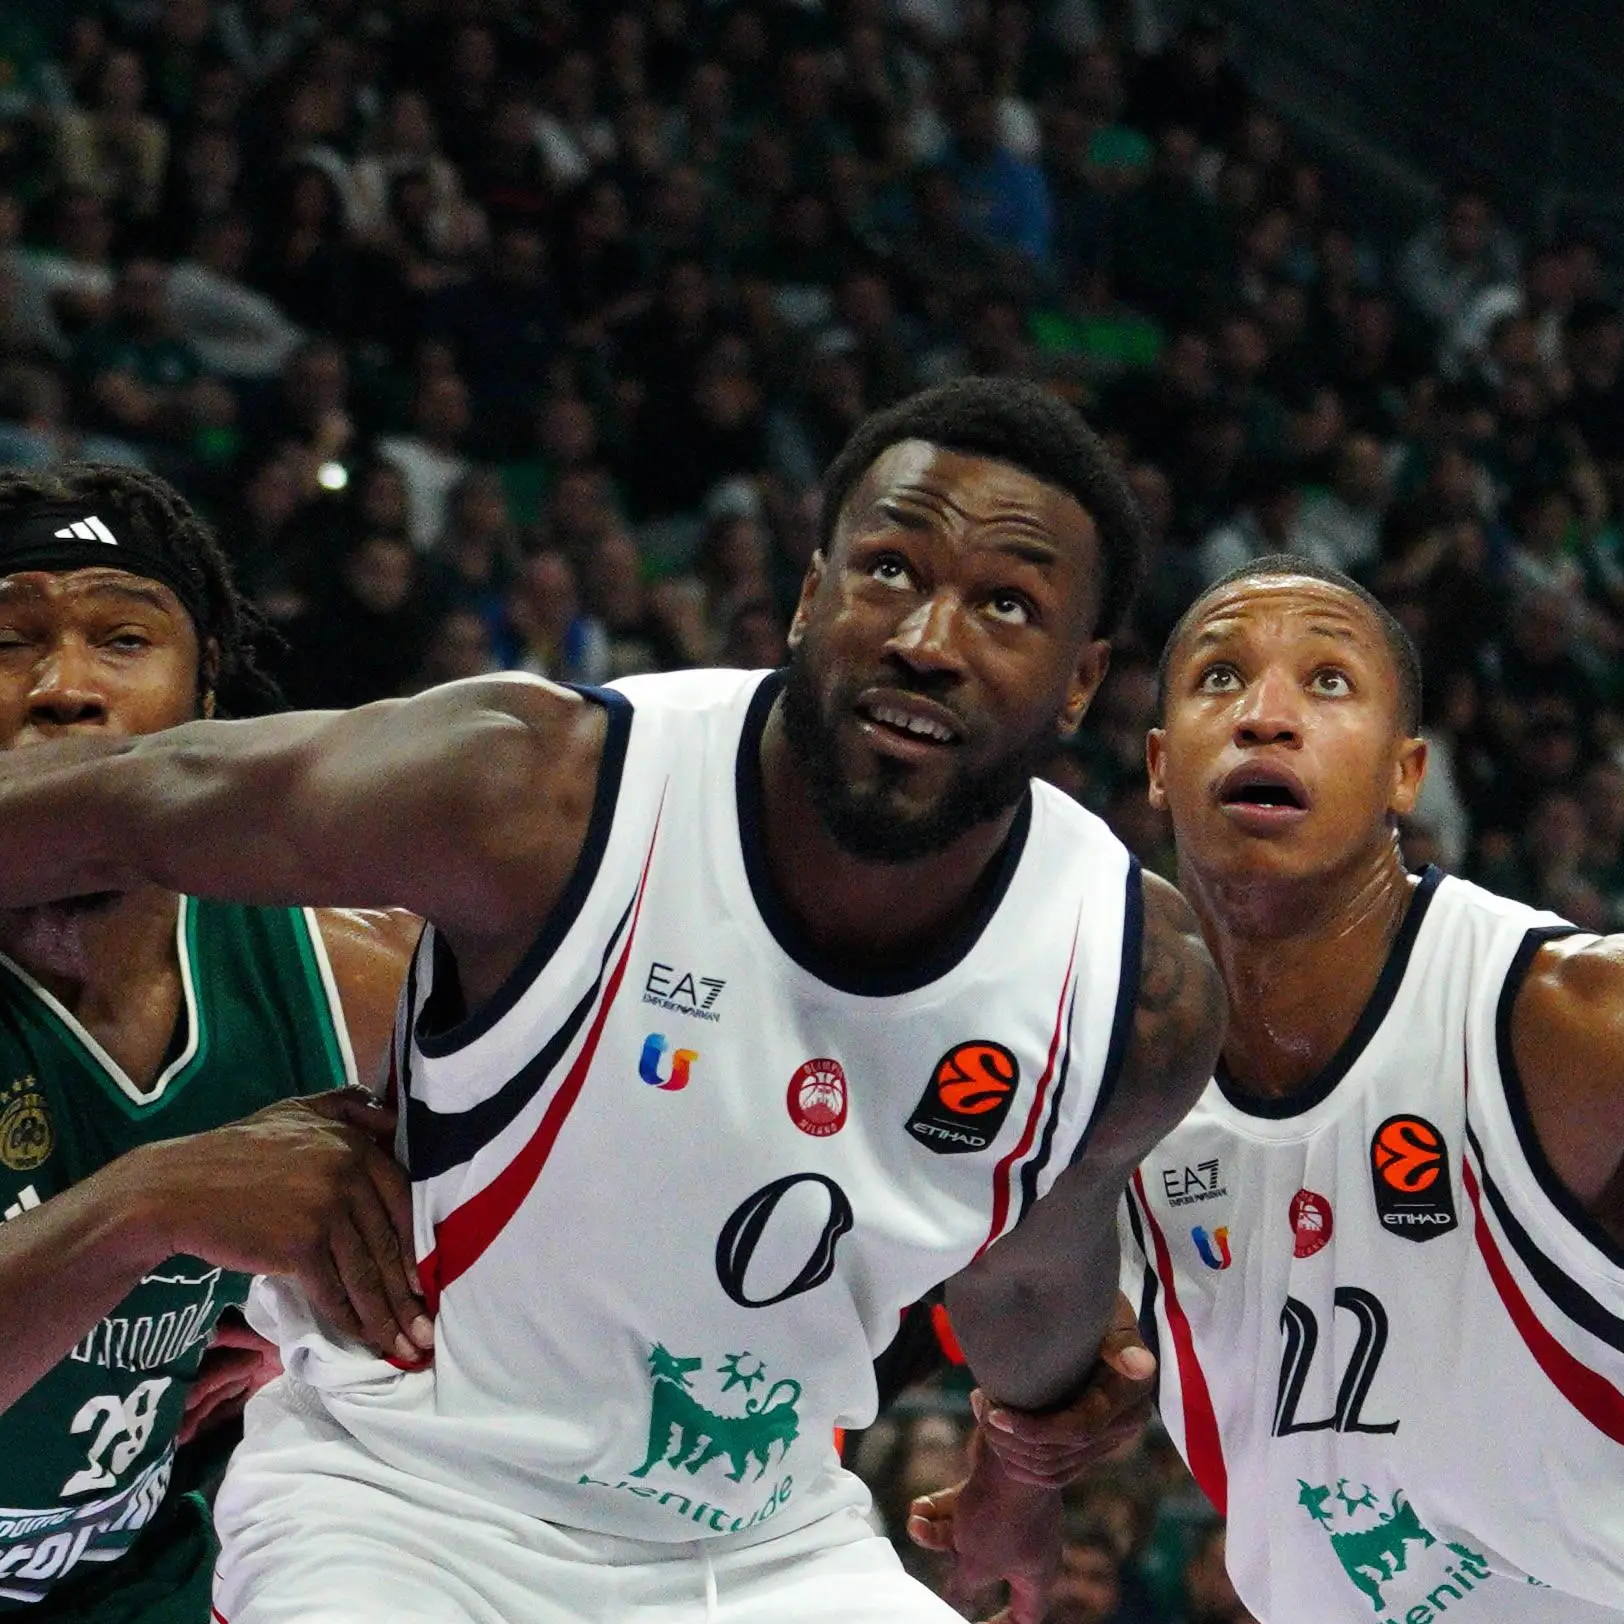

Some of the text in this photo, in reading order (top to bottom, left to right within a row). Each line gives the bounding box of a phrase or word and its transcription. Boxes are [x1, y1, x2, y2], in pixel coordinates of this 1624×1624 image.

[645, 961, 727, 1010] EA7
[913, 1122, 987, 1147] ETIHAD
[1162, 1158, 1220, 1199] EA7
[715, 1172, 854, 1309] 0
[1383, 1212, 1452, 1225] ETIHAD
[1271, 1286, 1401, 1438] 22
